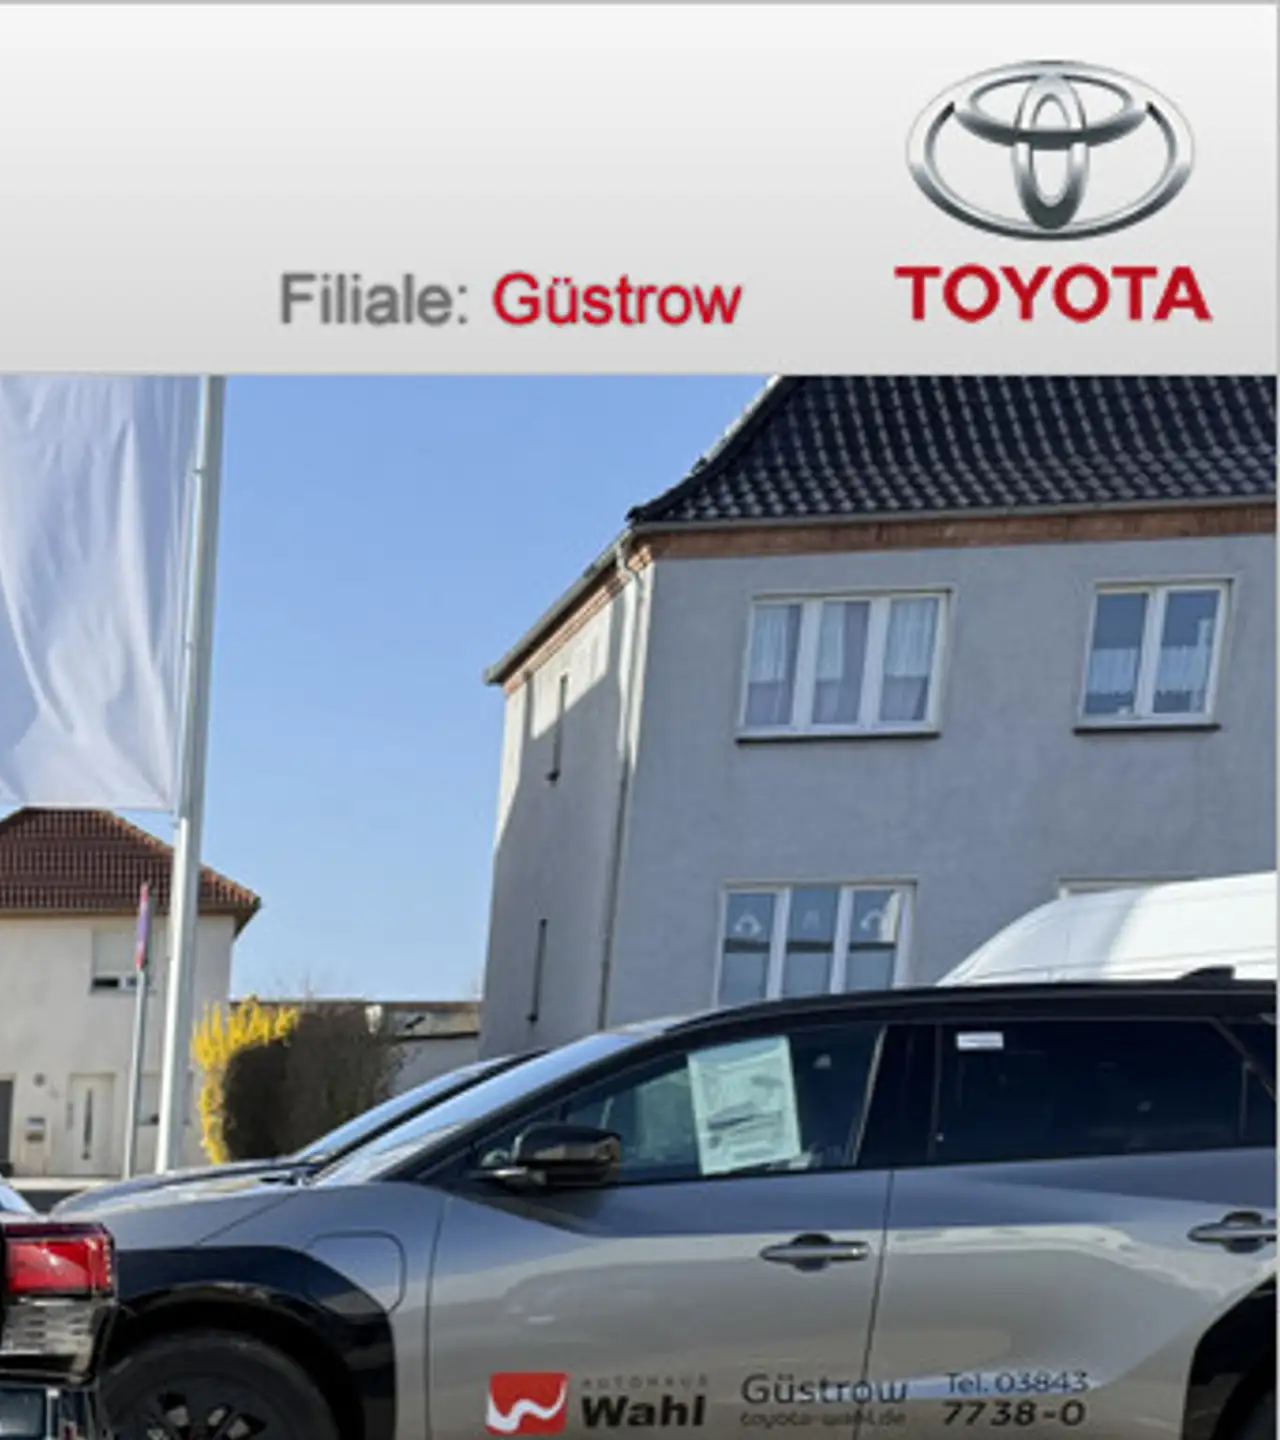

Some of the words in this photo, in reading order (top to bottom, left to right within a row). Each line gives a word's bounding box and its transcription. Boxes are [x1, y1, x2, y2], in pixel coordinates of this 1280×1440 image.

[741, 1371, 908, 1405] Güstrow
[944, 1372, 988, 1394] Tel.
[995, 1371, 1089, 1394] 03843
[581, 1395, 707, 1428] Wahl
